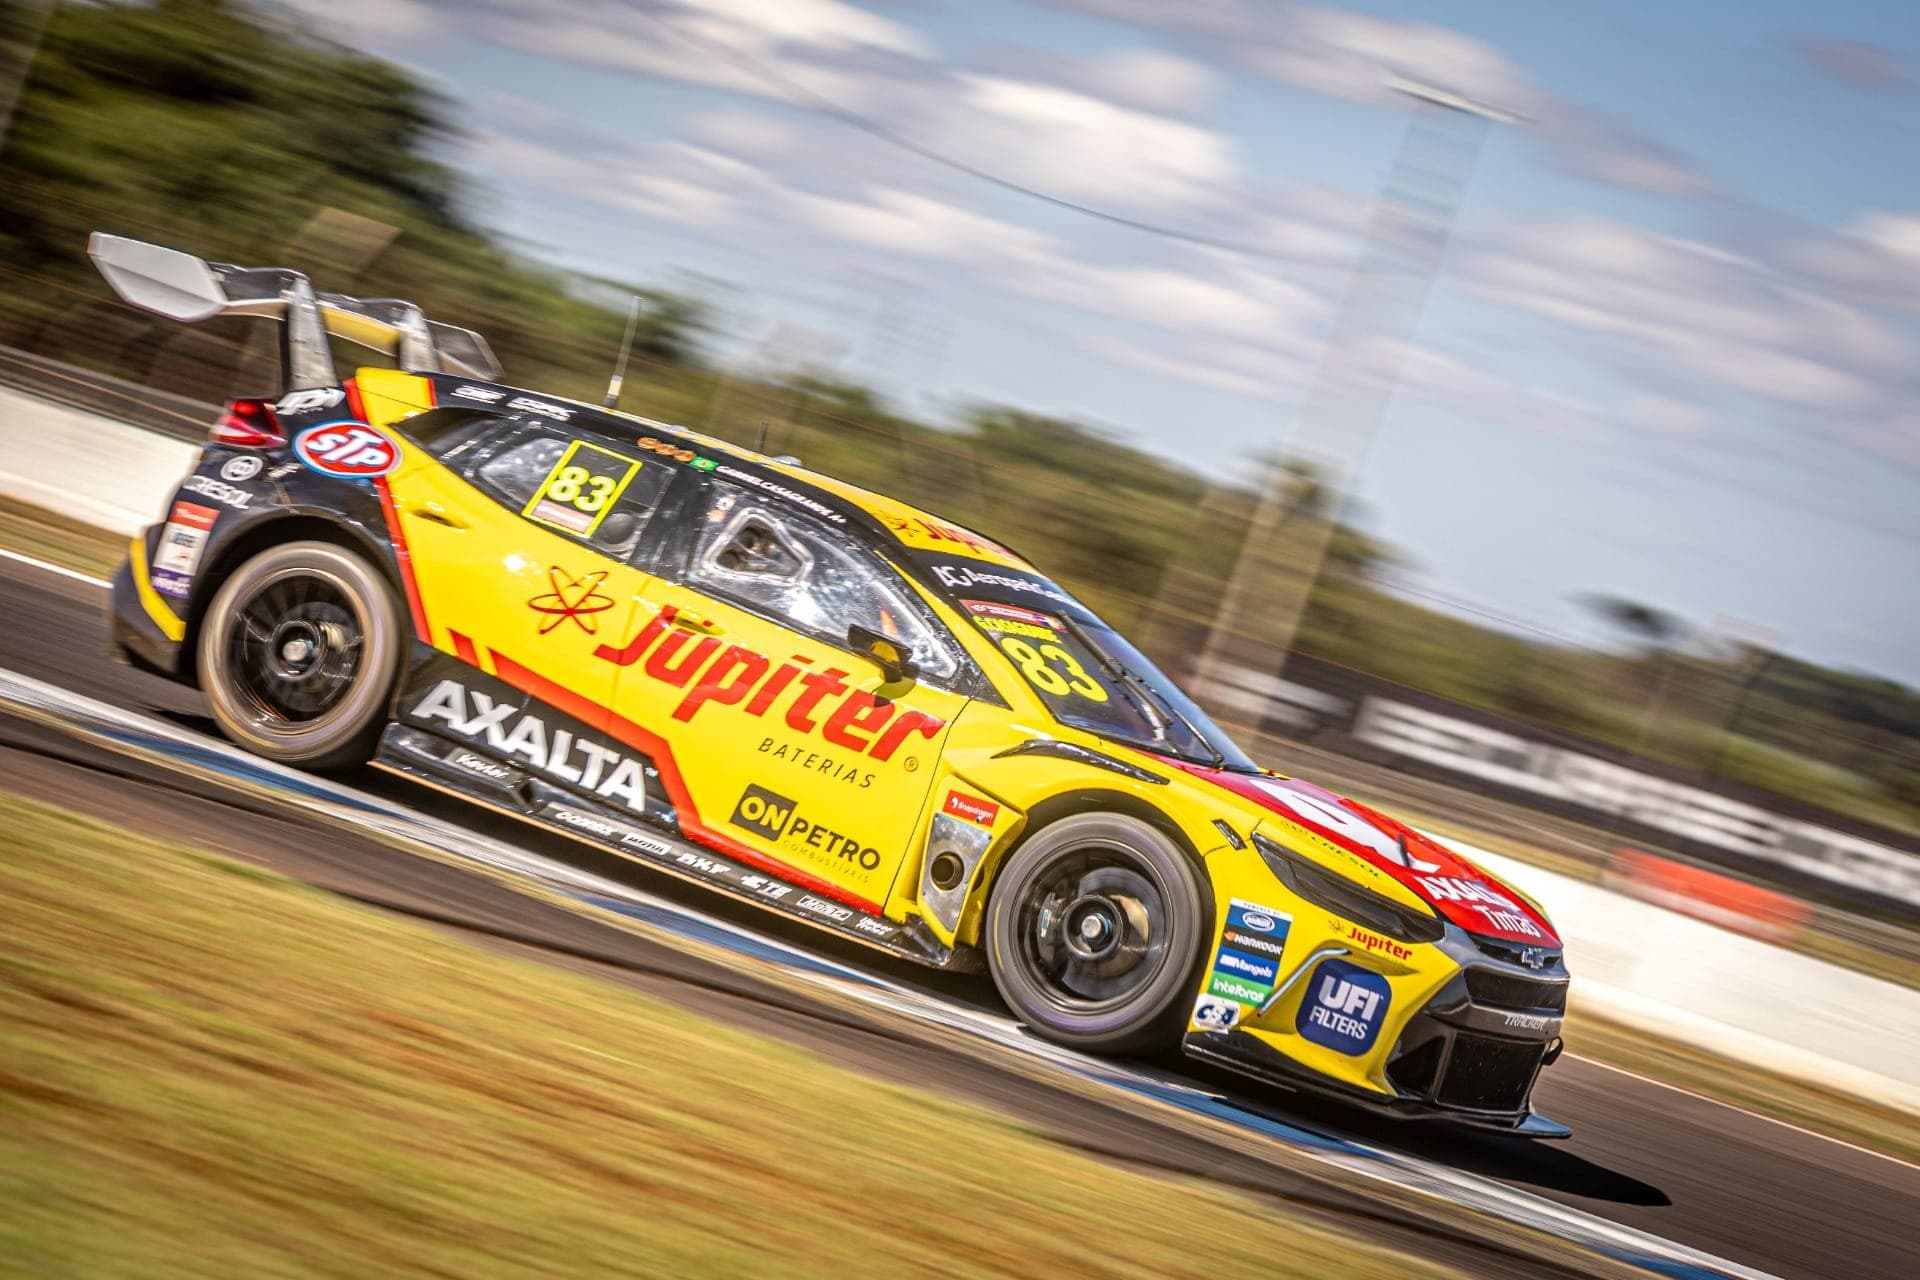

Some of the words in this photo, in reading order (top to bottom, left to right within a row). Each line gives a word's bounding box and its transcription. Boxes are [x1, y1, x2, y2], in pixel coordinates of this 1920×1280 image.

[305, 428, 391, 467] STP
[546, 465, 617, 512] 83
[1001, 637, 1109, 702] 83
[411, 680, 646, 812] AXALTA
[758, 737, 876, 788] BATERIAS
[788, 817, 880, 870] PETRO
[1212, 977, 1266, 1003] intelbras
[1318, 974, 1380, 1022] UFI
[1309, 1004, 1369, 1041] FILTERS
